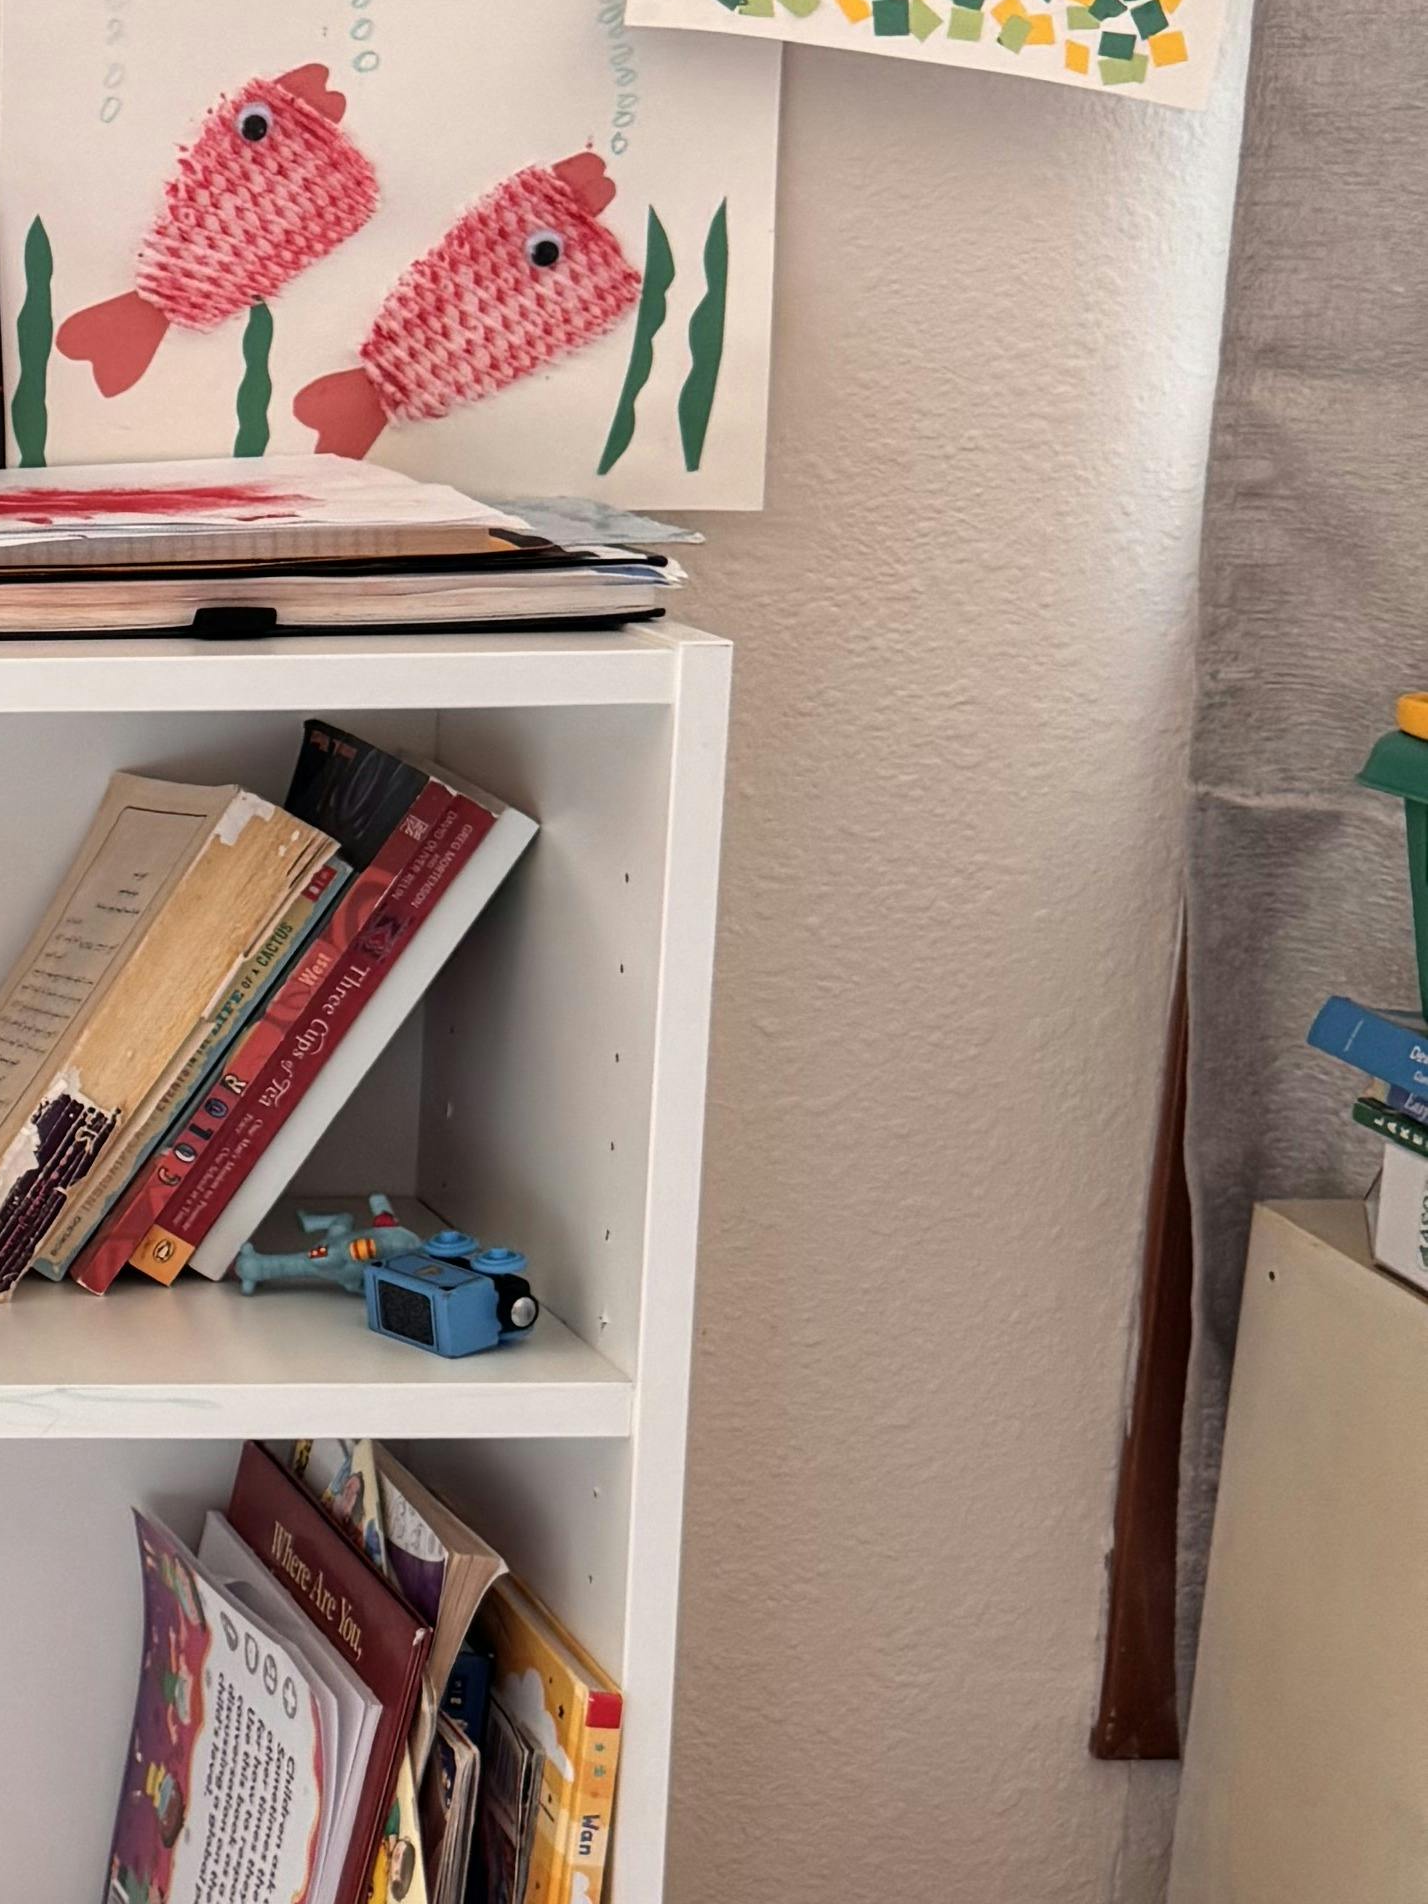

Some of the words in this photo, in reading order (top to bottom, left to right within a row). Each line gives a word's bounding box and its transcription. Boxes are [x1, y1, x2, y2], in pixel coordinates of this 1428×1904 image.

[255, 921, 294, 968] CACTUS
[298, 951, 332, 988] West
[330, 962, 370, 1017] Three
[293, 1019, 330, 1062] Cups
[258, 1076, 289, 1109] Tea
[156, 1072, 249, 1188] COLOR
[271, 1519, 312, 1591] Where
[309, 1569, 337, 1621] Are
[338, 1597, 362, 1661] You,
[262, 1730, 274, 1792] other
[251, 1795, 267, 1853] times
[261, 1742, 285, 1863] Sometimes
[276, 1755, 295, 1849] Children
[578, 1813, 601, 1857] Wan
